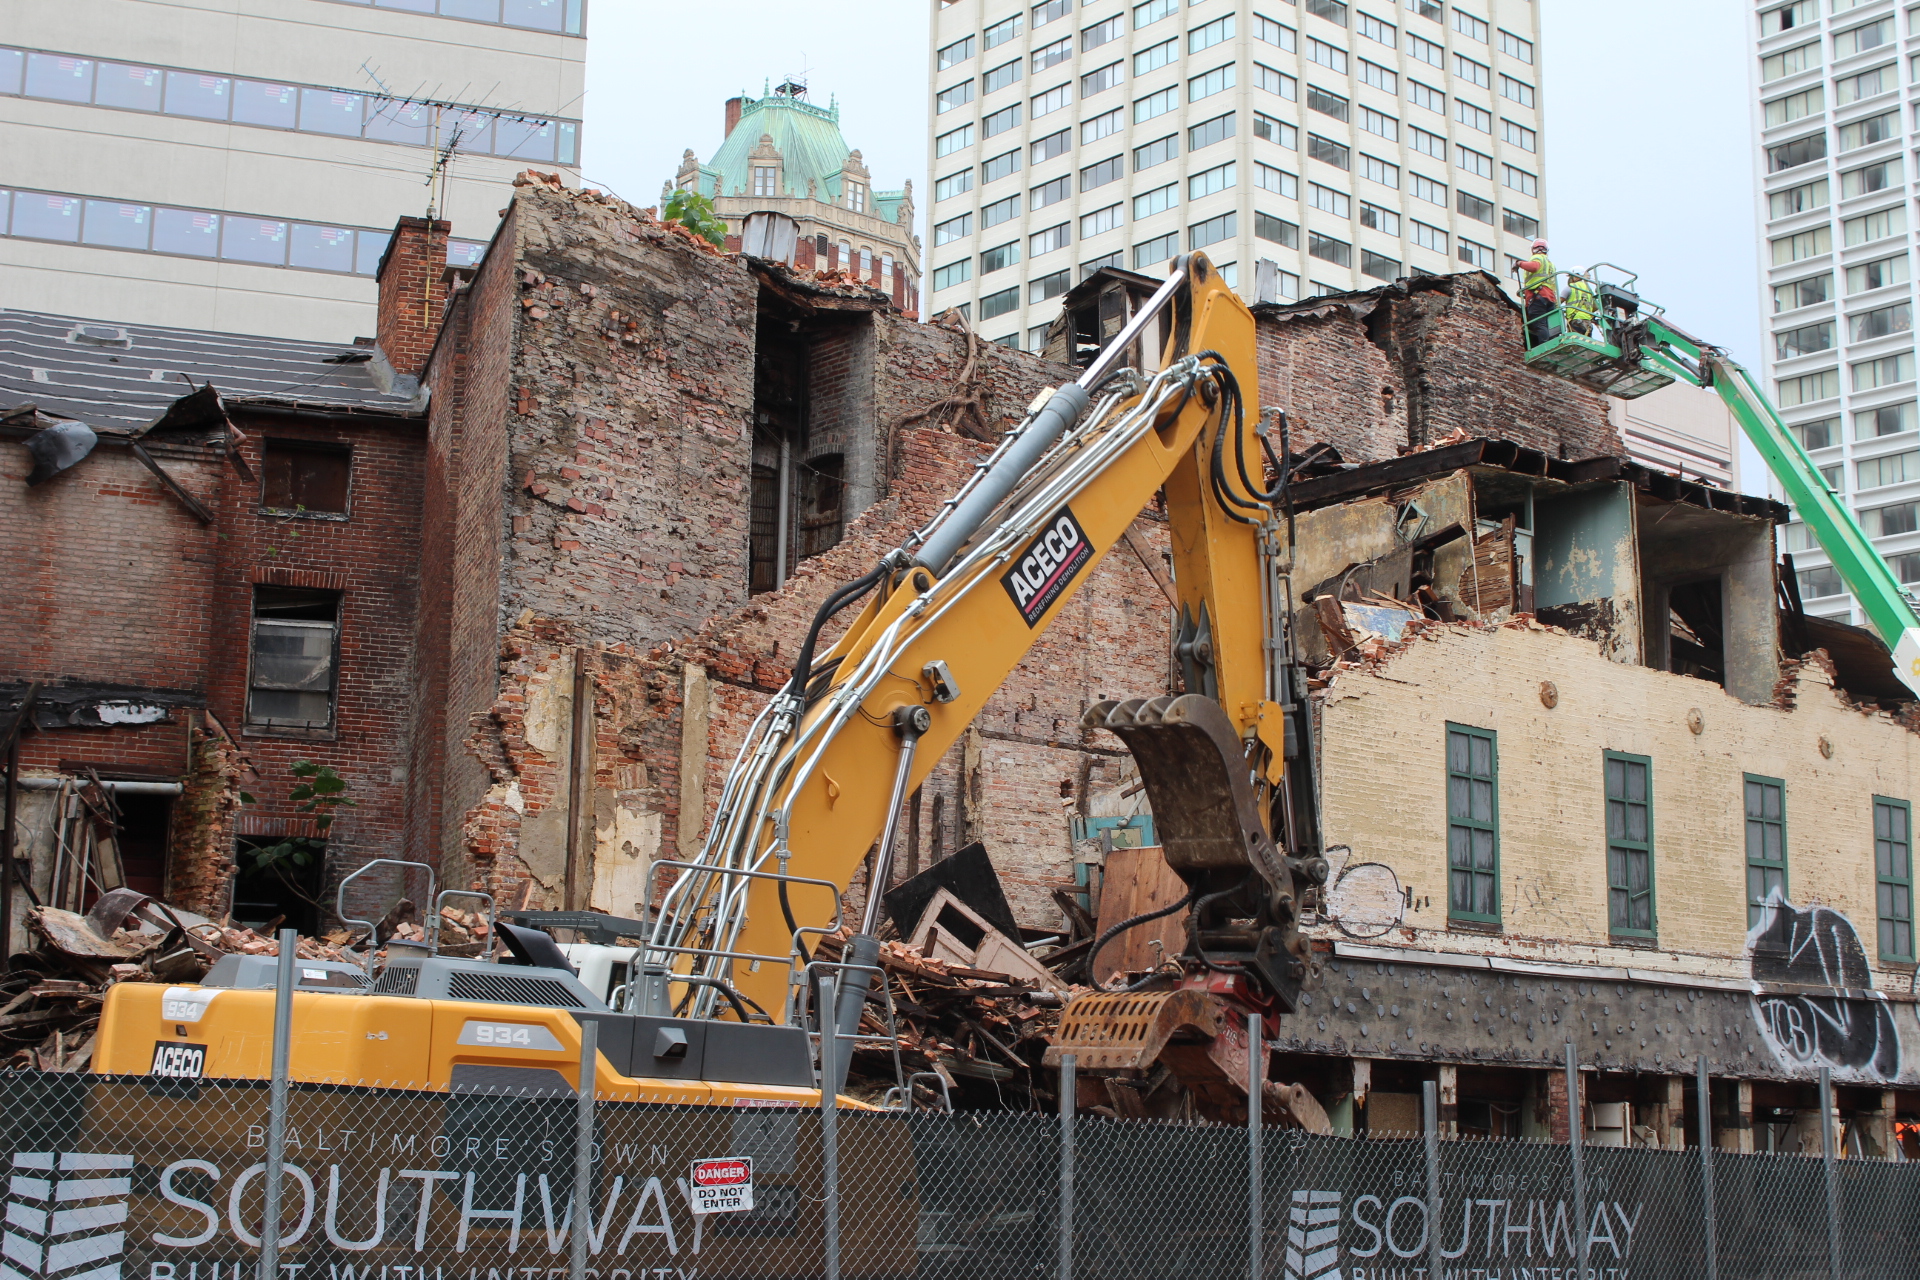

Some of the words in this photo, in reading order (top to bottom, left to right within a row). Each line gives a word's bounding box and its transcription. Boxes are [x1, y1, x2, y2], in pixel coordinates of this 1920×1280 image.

[1010, 516, 1079, 607] ACECO
[1028, 585, 1060, 621] REDEFINING
[1058, 547, 1090, 586] DEMOLITION
[167, 1001, 198, 1019] 934
[476, 1025, 531, 1045] 934
[152, 1046, 203, 1078] ACECO
[247, 1124, 554, 1162] BALTIMORE'S
[698, 1166, 745, 1179] DANGER
[1394, 1171, 1549, 1191] BATIMORE'S
[698, 1189, 717, 1199] DO
[720, 1187, 745, 1197] NOT
[152, 1158, 706, 1256] SOUTHWAY
[703, 1198, 740, 1209] ENTER
[1349, 1194, 1643, 1259] SOUTHWAY
[151, 1262, 306, 1280] BUIT
